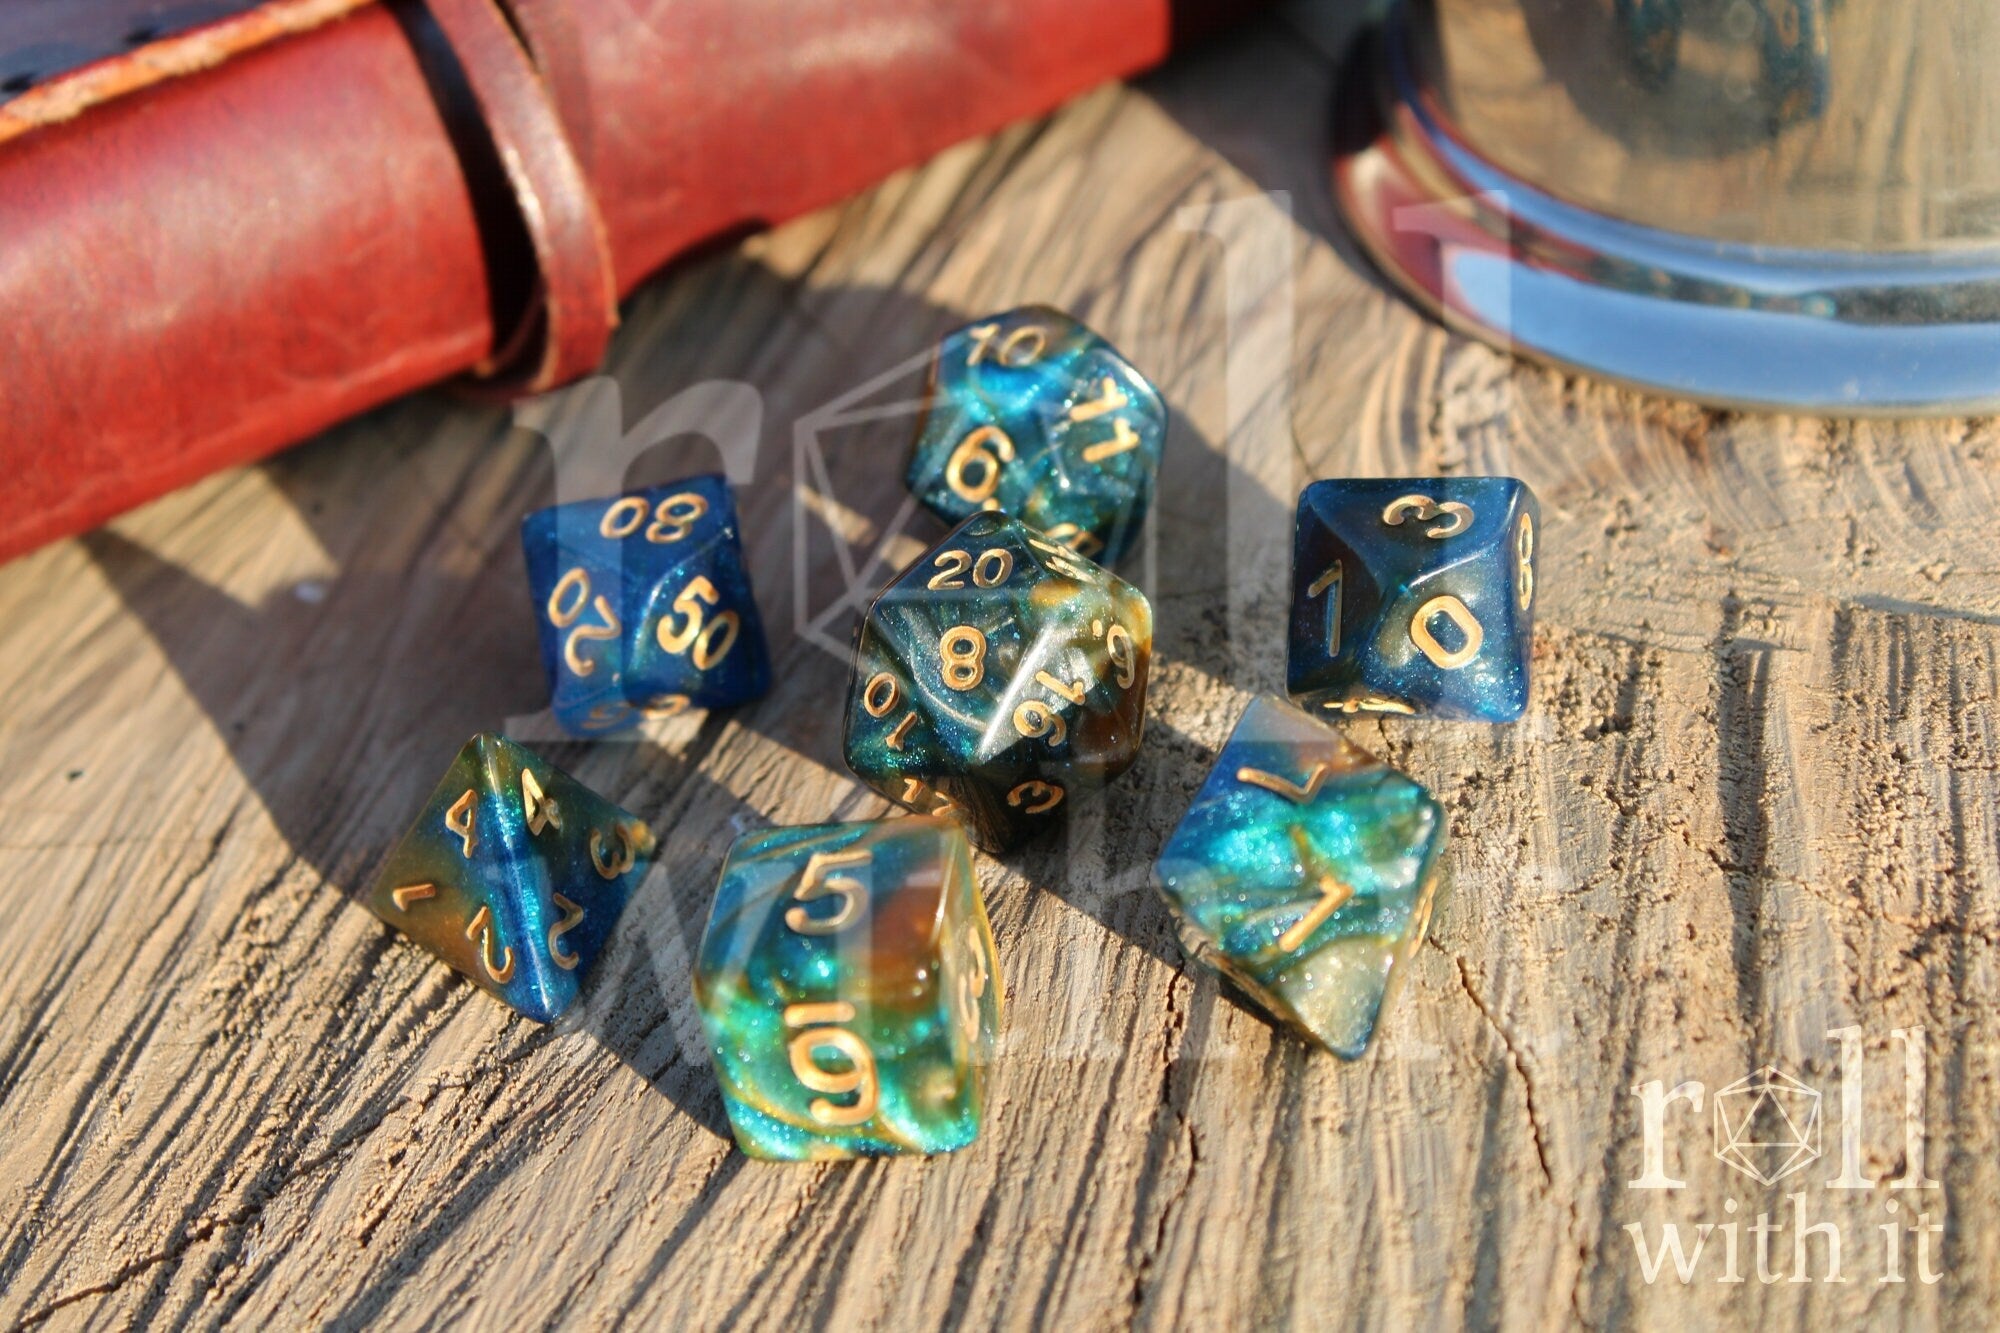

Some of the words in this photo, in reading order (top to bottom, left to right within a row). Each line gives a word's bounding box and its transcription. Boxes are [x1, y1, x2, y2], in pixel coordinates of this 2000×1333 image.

[966, 324, 1048, 367] 10
[1069, 377, 1141, 463] 11
[1382, 494, 1474, 539] 3
[927, 547, 1014, 590] 20
[656, 575, 740, 671] 50
[1307, 558, 1343, 657] 1
[1411, 595, 1484, 670] 0
[940, 625, 987, 690] 8
[445, 789, 478, 859] 4
[521, 768, 561, 836] 4
[1006, 779, 1065, 814] 3
[590, 823, 635, 880] 3
[785, 850, 872, 935] 5
[466, 906, 515, 984] 2
[547, 892, 584, 970] 2
